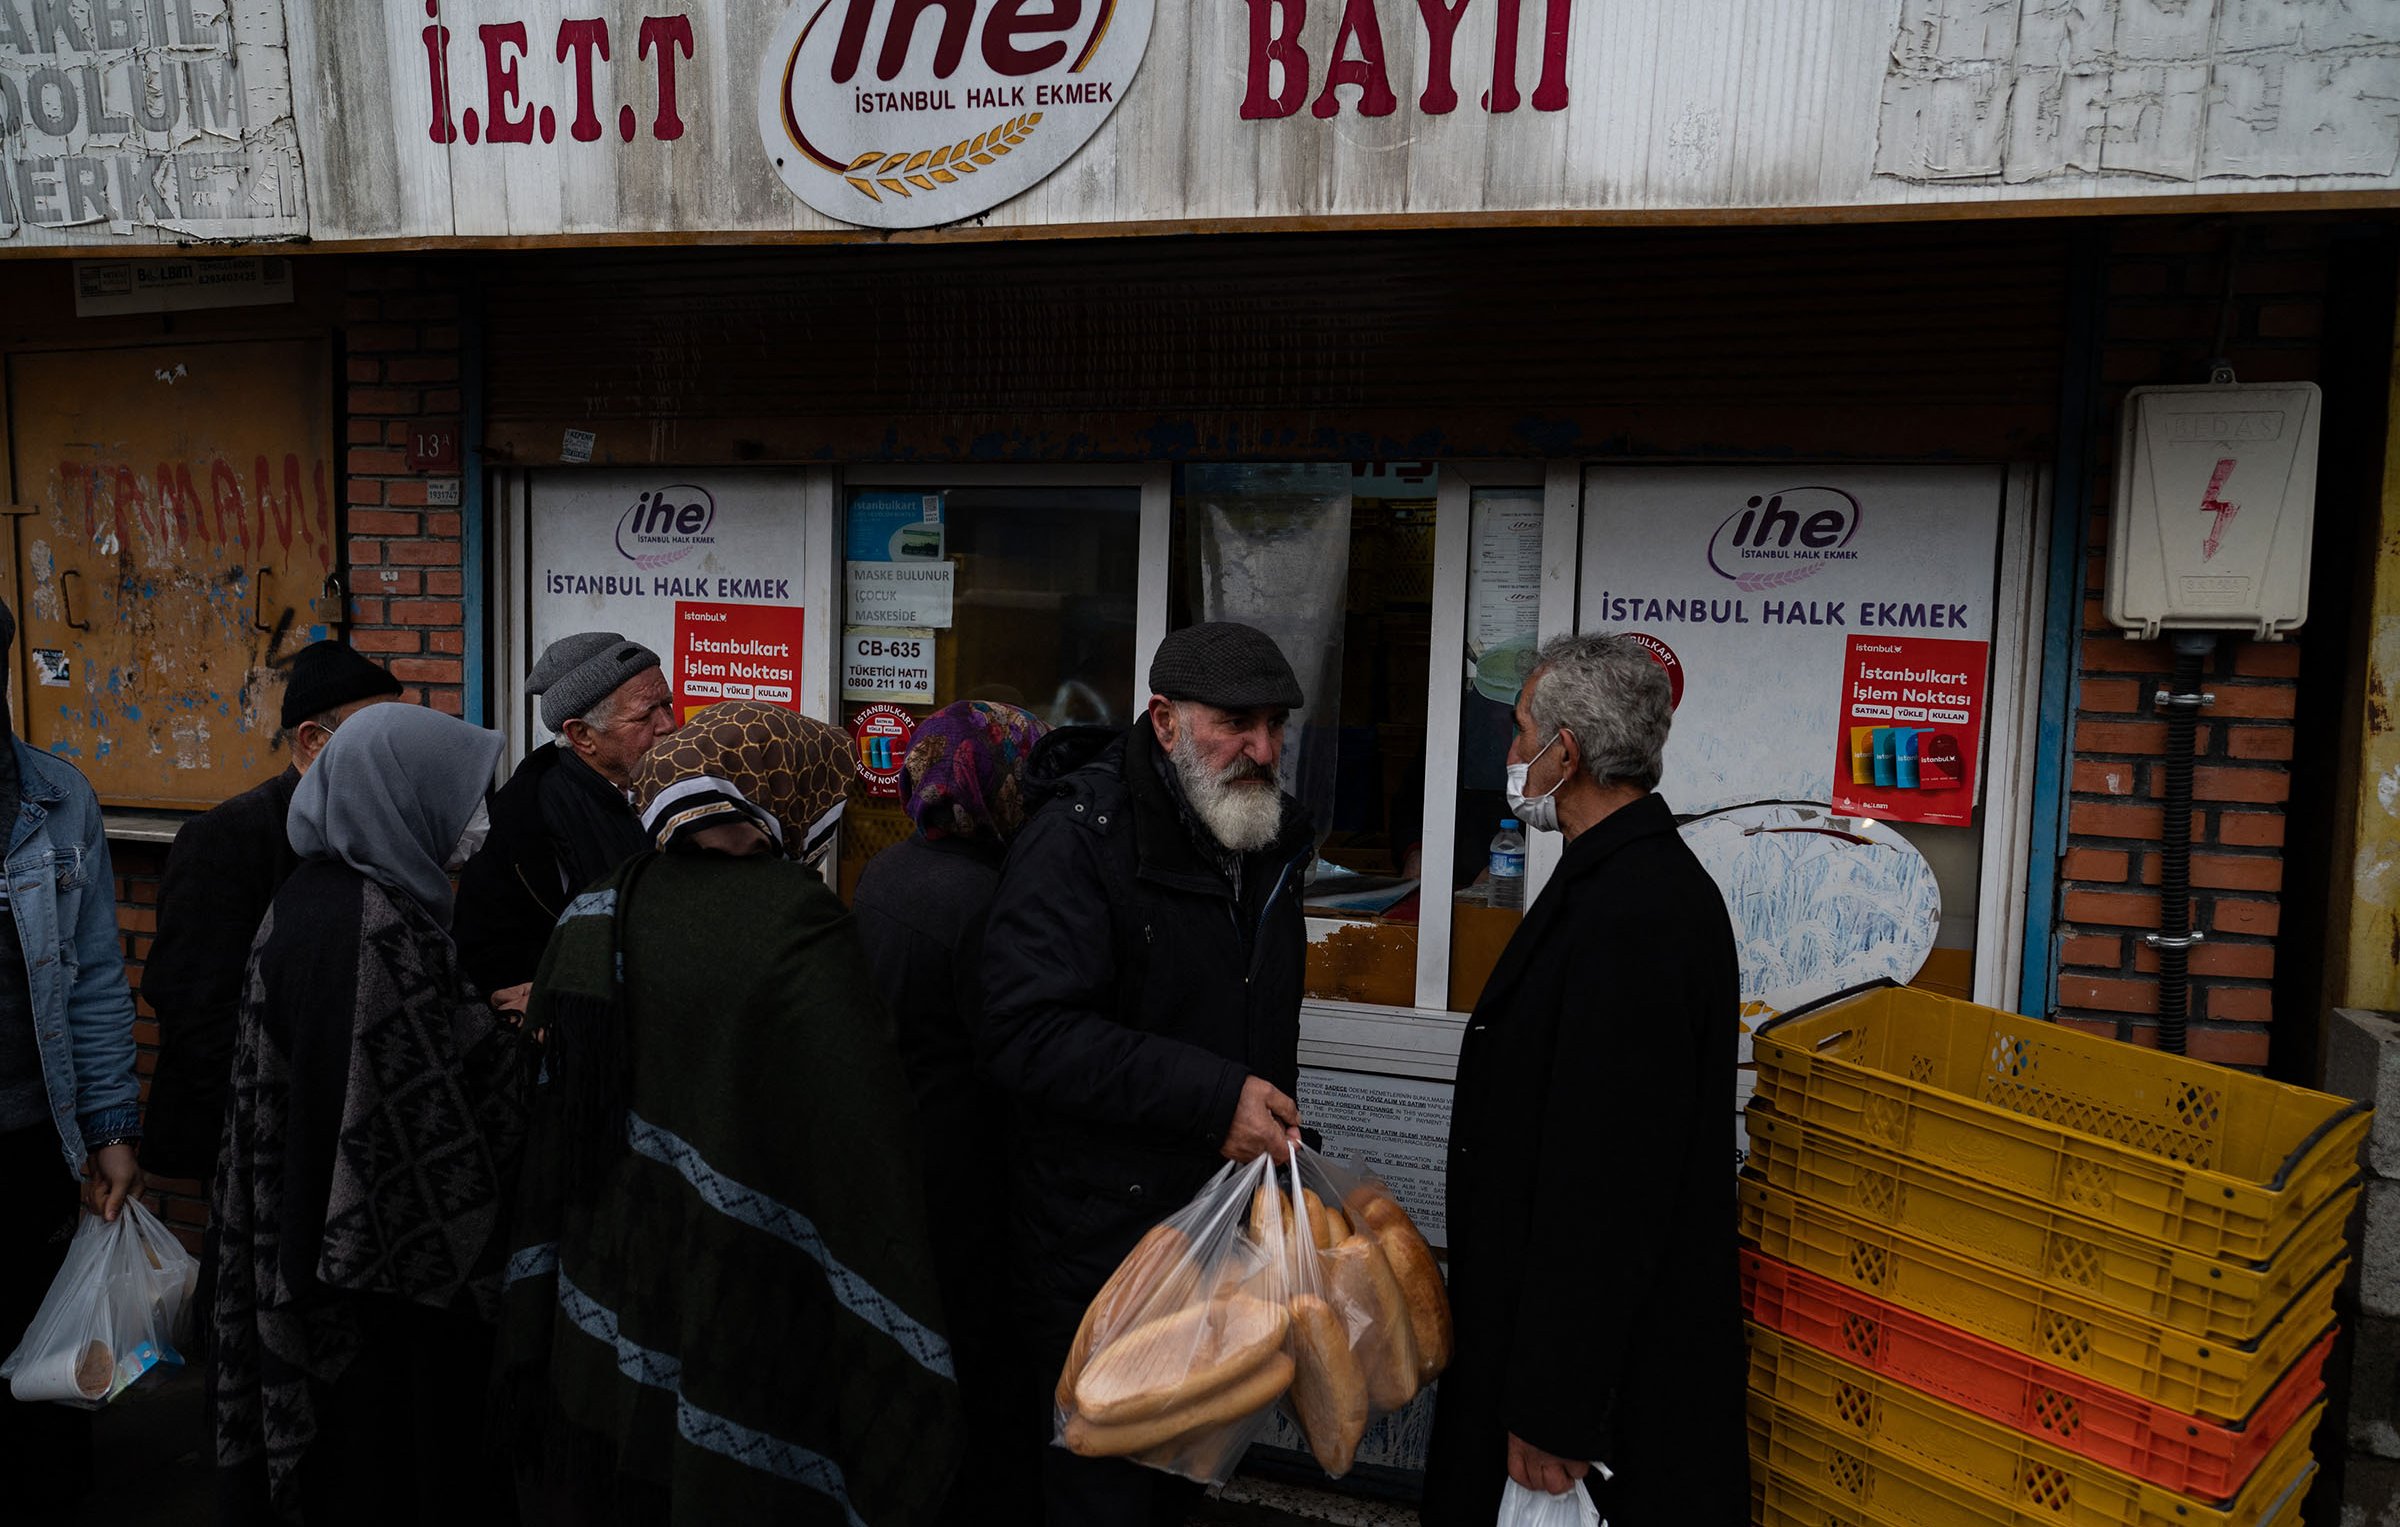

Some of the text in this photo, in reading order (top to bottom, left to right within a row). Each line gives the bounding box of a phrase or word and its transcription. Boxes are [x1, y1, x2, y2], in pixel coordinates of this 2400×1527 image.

[855, 81, 1114, 114] İSTANBUL HALK EKMEK
[632, 491, 705, 535] ihe
[1732, 495, 1845, 548] ihe
[637, 534, 715, 545] İSTANBUL HALK EKMEK
[1741, 548, 1858, 560] İSTANBUL HALK EKMEK
[854, 570, 950, 582] MASKE BULUNUR
[546, 569, 790, 600] İSTANBUL HALK EKMEK
[855, 589, 897, 603] (ÇOCUK
[855, 608, 917, 622] MASKESİDE
[1601, 591, 1968, 629] İSTANBUL HALK EKMEK
[690, 632, 789, 658] İstanbulkart
[857, 639, 921, 658] CB-635
[684, 654, 793, 681] İşlem Noktası
[849, 664, 928, 679] TÜKETİCİ HATTI
[1860, 661, 1968, 686] İstanbulkart
[687, 684, 719, 694] SATIN AL
[848, 677, 928, 690] 0800 211 10 49
[726, 686, 750, 696] YÜKLE
[758, 689, 788, 698] KULLAN
[1853, 681, 1971, 706] İşlem Noktası
[853, 704, 915, 729] İSTANBULKART
[1855, 707, 1890, 716] SATIN AL
[1897, 709, 1924, 718] YÜKLE
[1932, 712, 1965, 721] KULLAN
